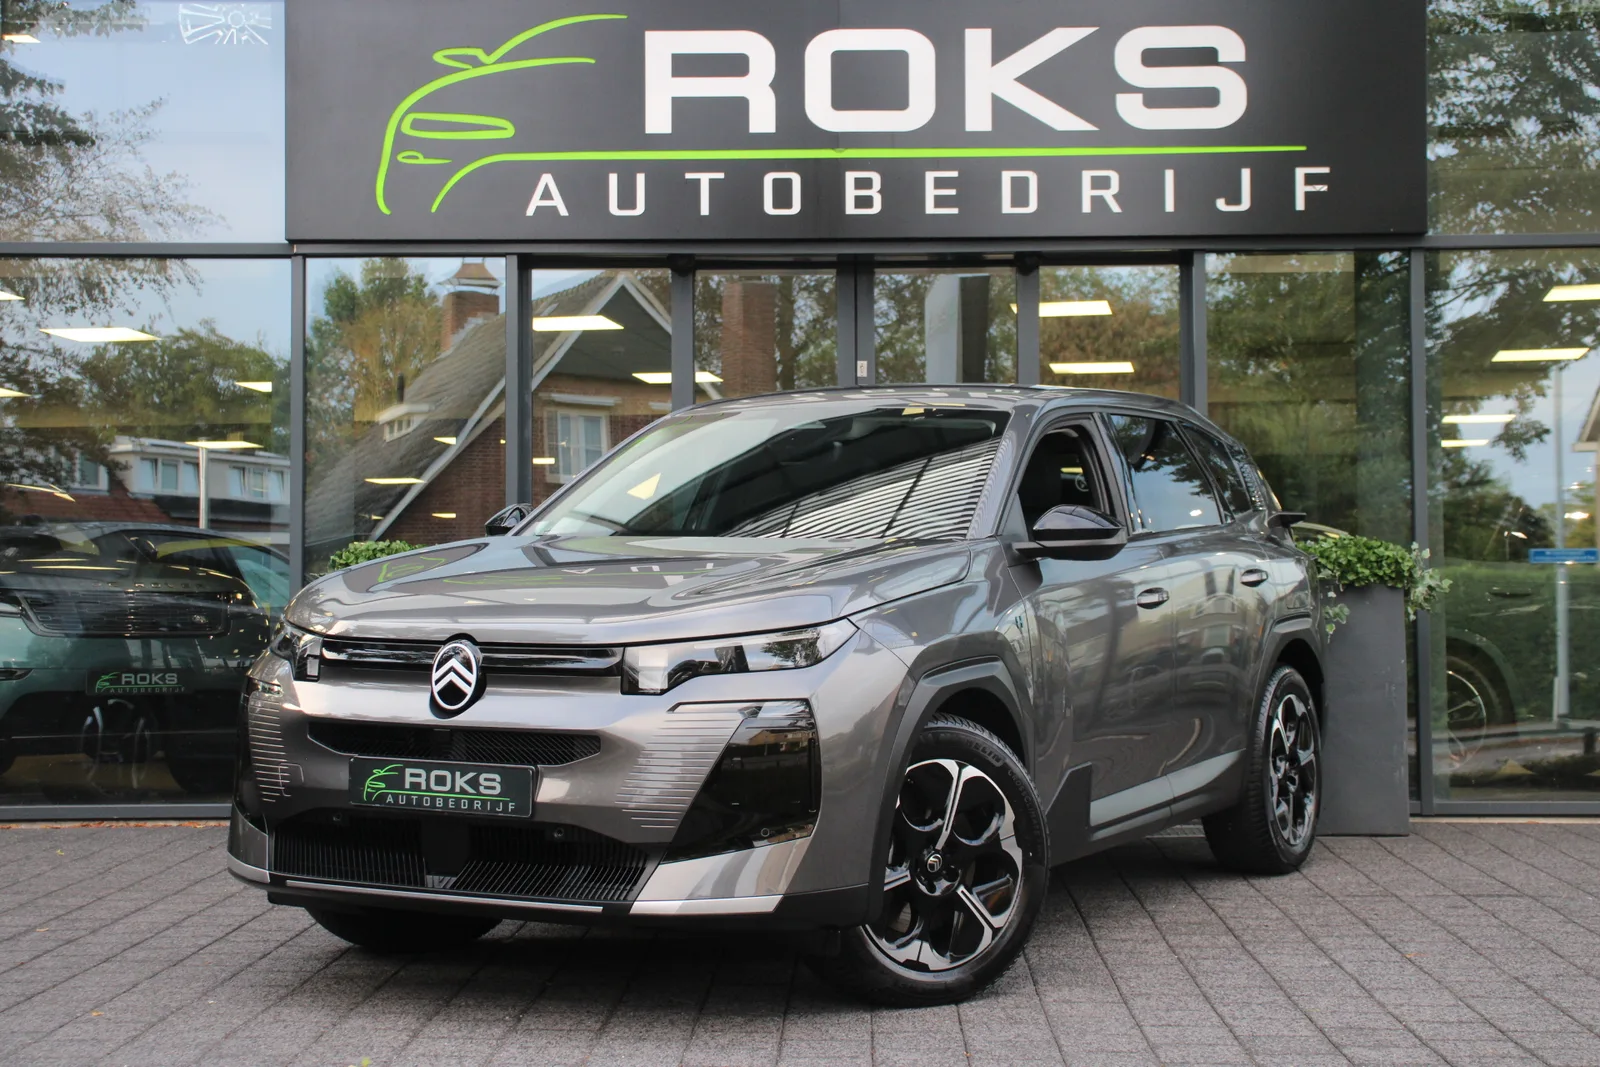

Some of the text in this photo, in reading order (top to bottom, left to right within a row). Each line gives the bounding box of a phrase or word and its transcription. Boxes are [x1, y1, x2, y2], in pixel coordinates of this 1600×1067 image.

[644, 25, 1248, 134] ROKS
[525, 167, 1330, 217] AUTOBEDRIJF
[121, 672, 178, 685] ROKS
[404, 767, 502, 795] ROKS
[385, 793, 516, 812] AUTOBEDRIJF
